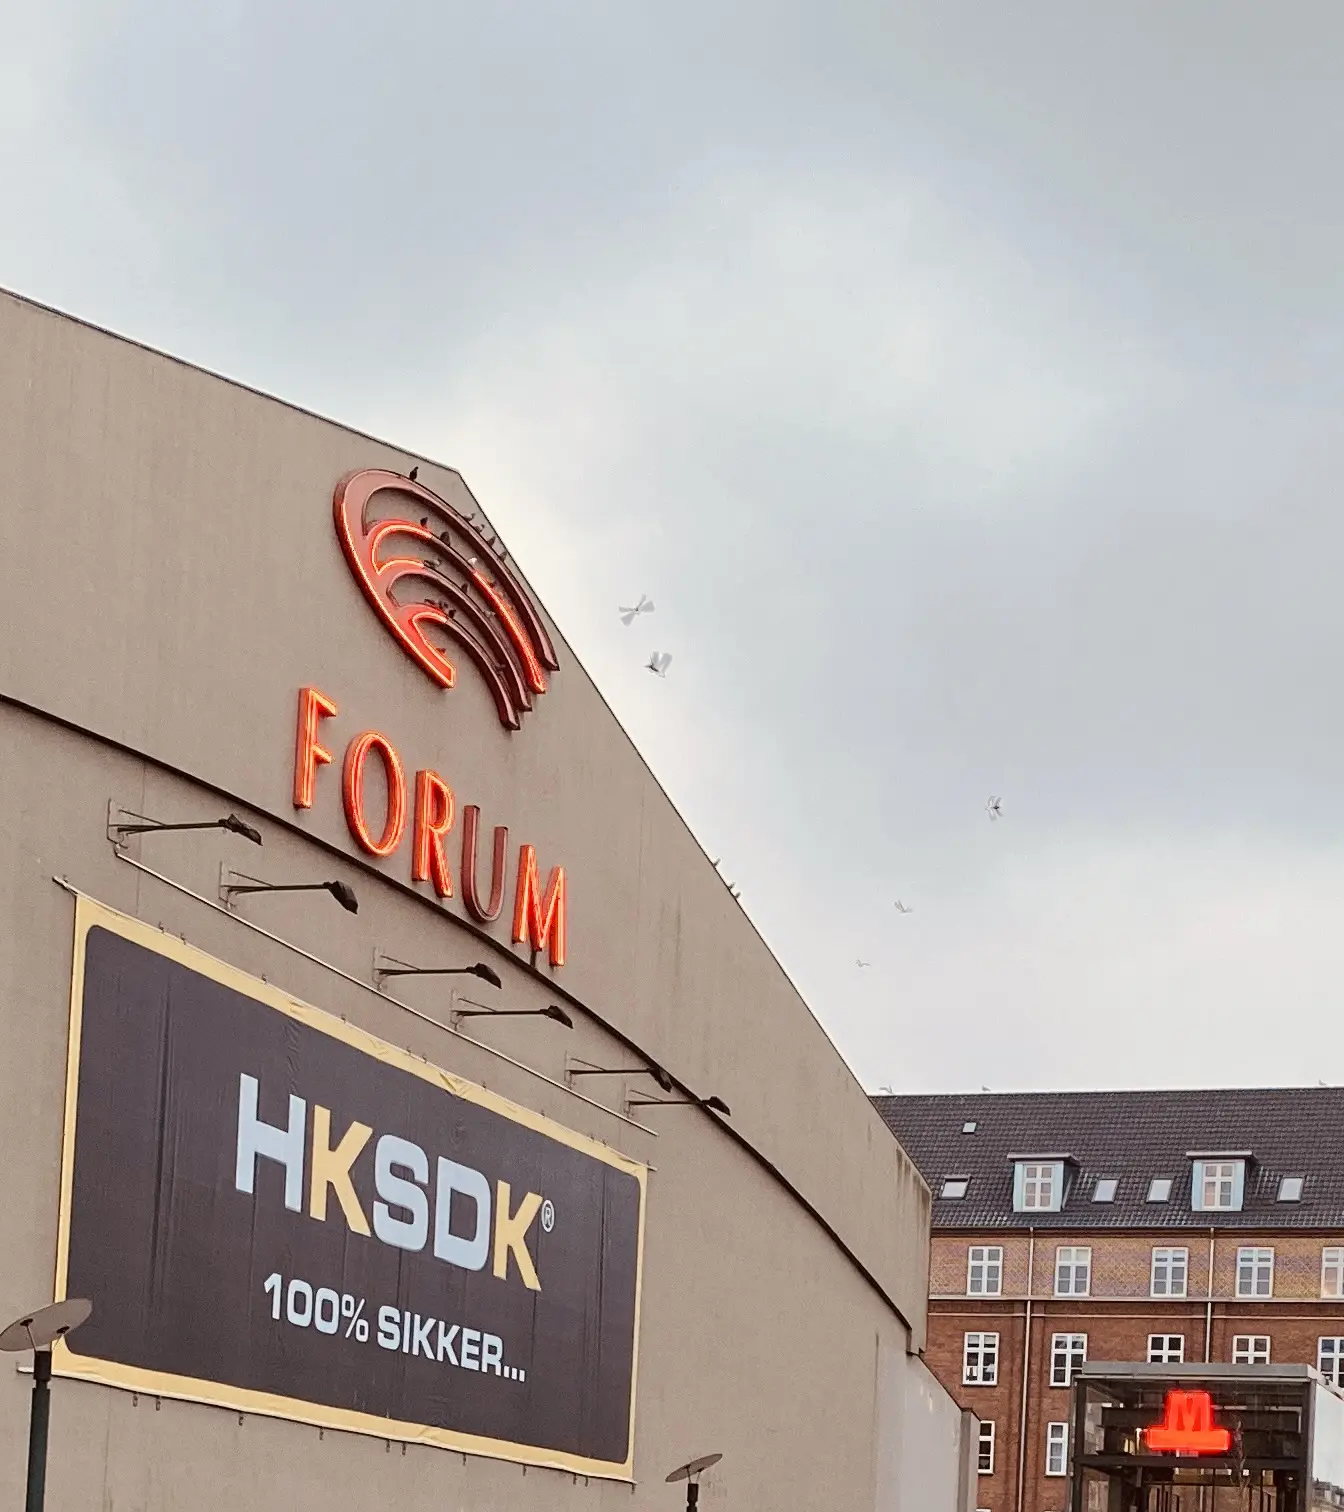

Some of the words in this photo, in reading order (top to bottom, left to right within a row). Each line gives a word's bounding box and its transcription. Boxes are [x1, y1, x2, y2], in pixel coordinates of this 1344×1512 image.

[293, 687, 568, 967] FORUM
[263, 1272, 369, 1343] 100%
[377, 1305, 526, 1382] SIKKER...
